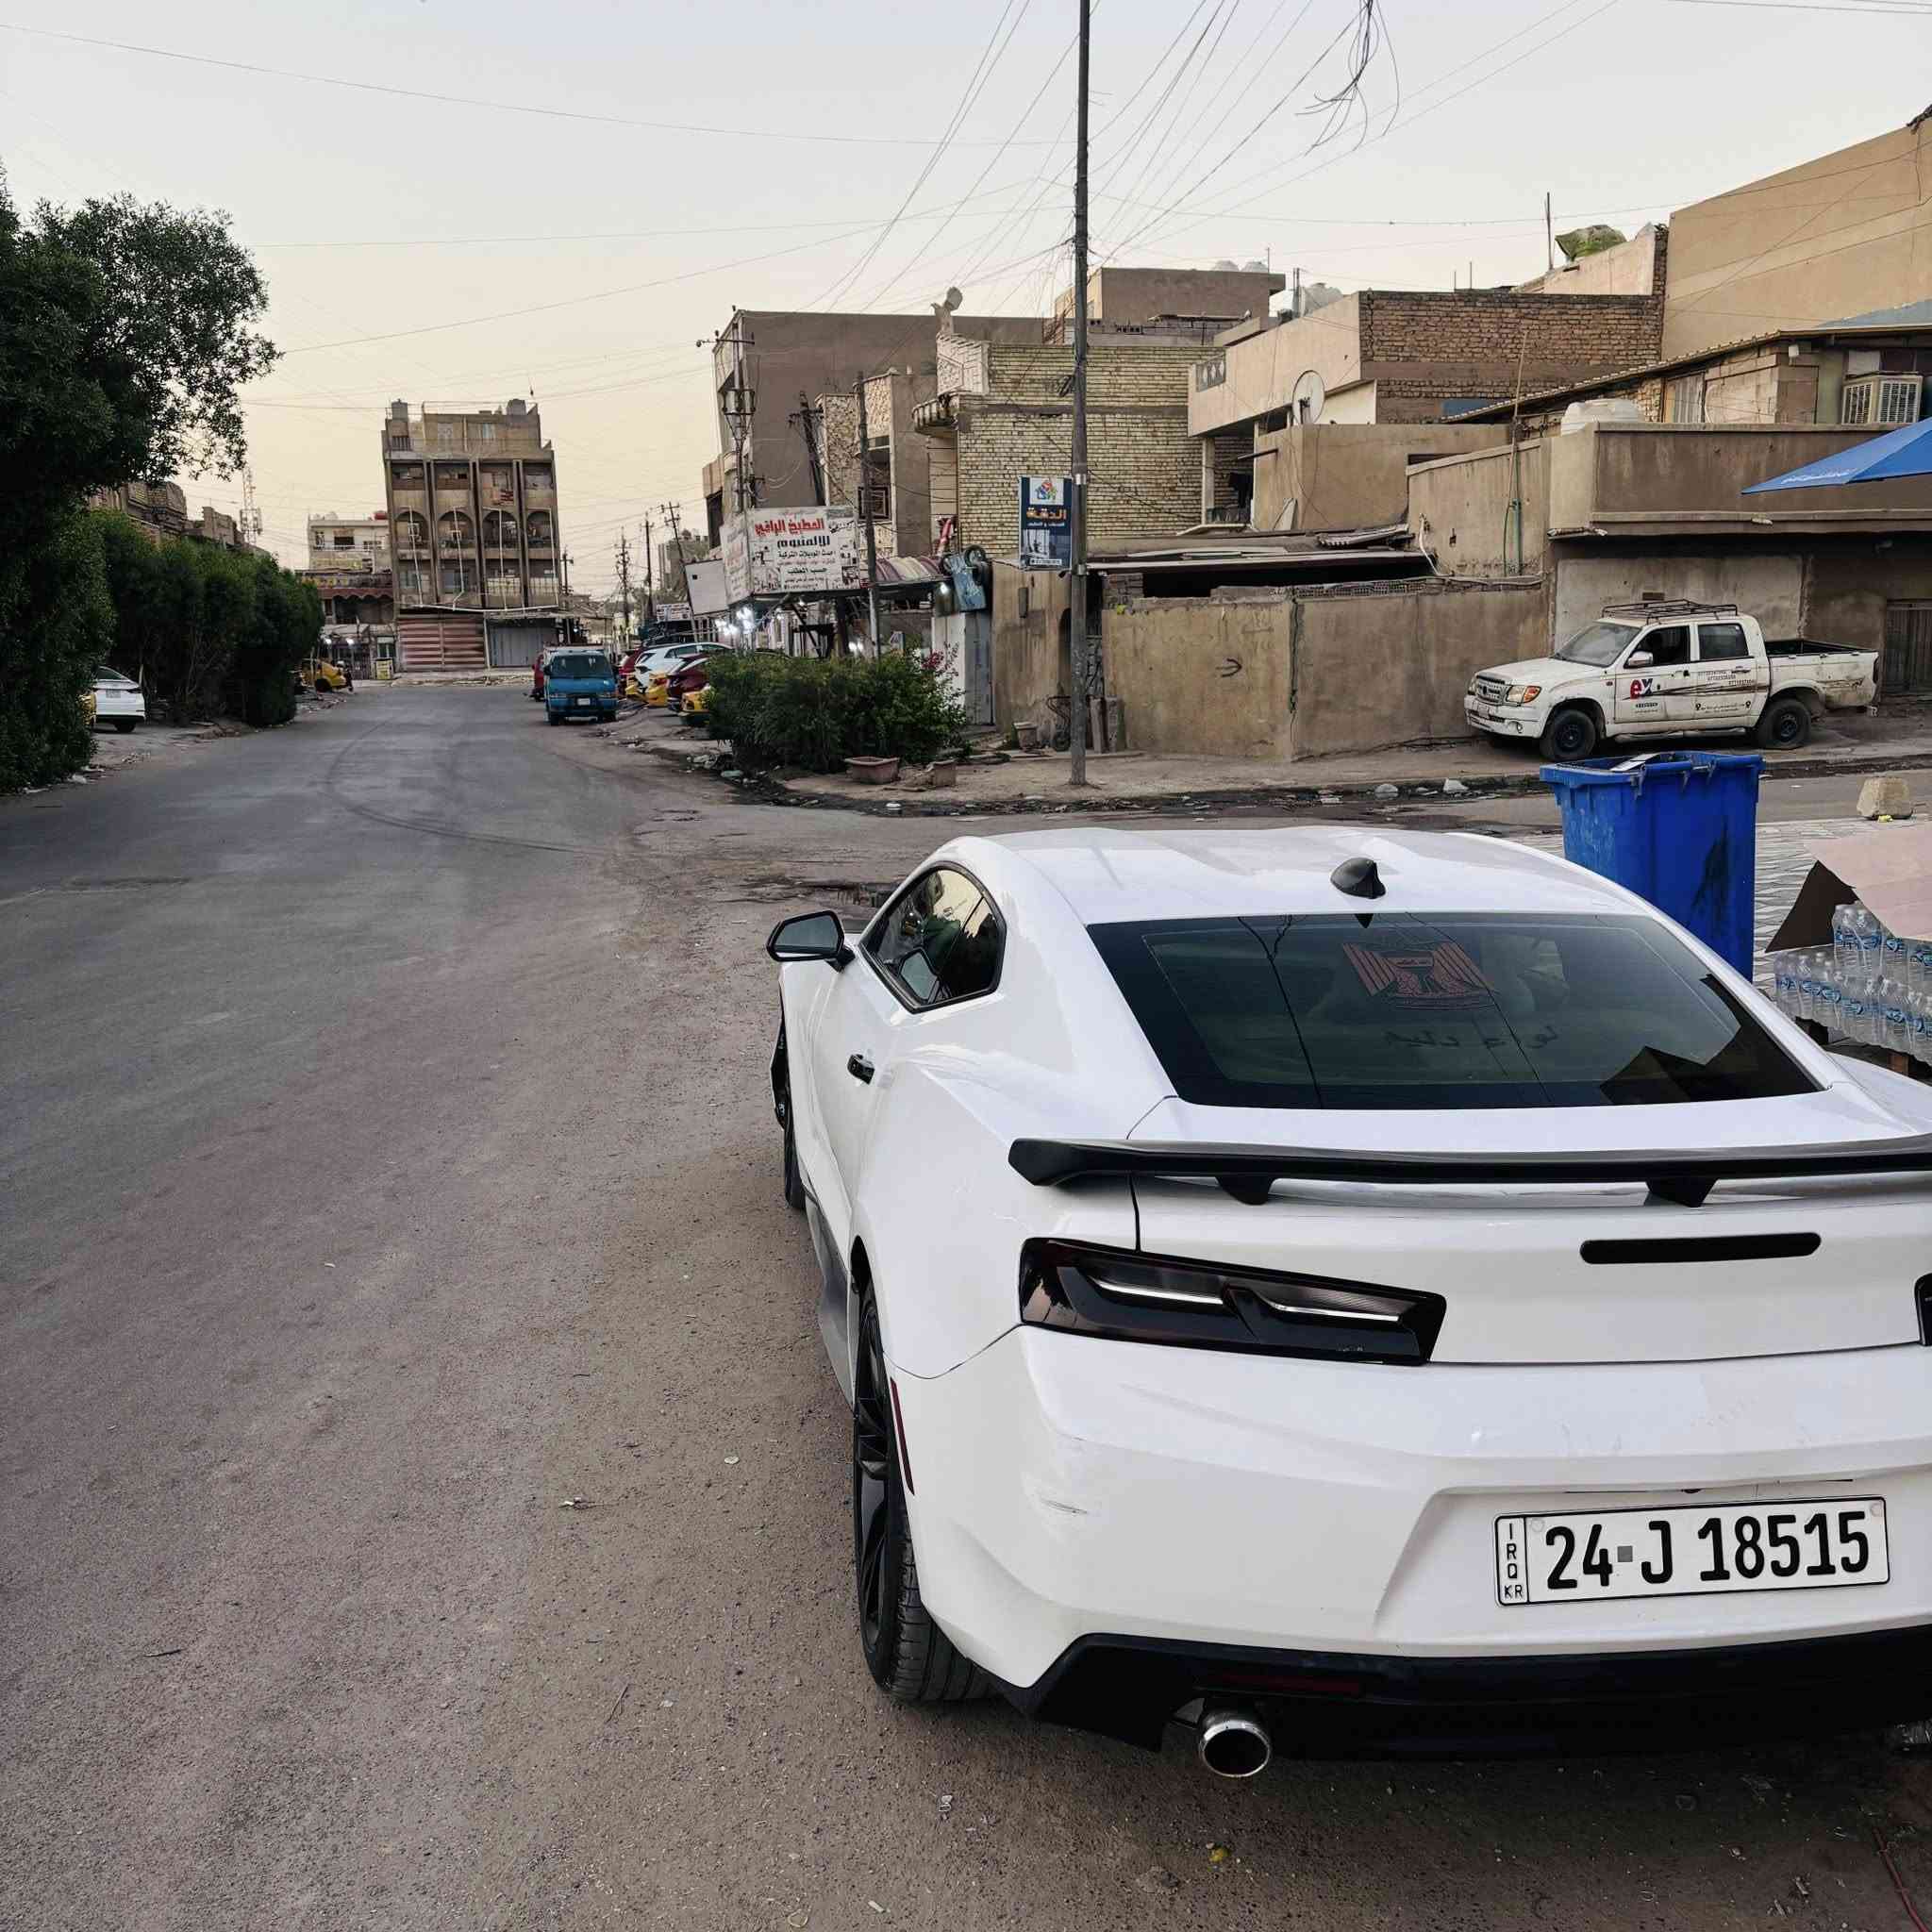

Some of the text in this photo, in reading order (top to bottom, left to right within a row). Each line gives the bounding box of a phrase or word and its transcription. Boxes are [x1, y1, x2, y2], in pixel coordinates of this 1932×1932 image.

[1545, 1510, 1869, 1590] 24 J 18515
[1504, 1584, 1524, 1599] KR
